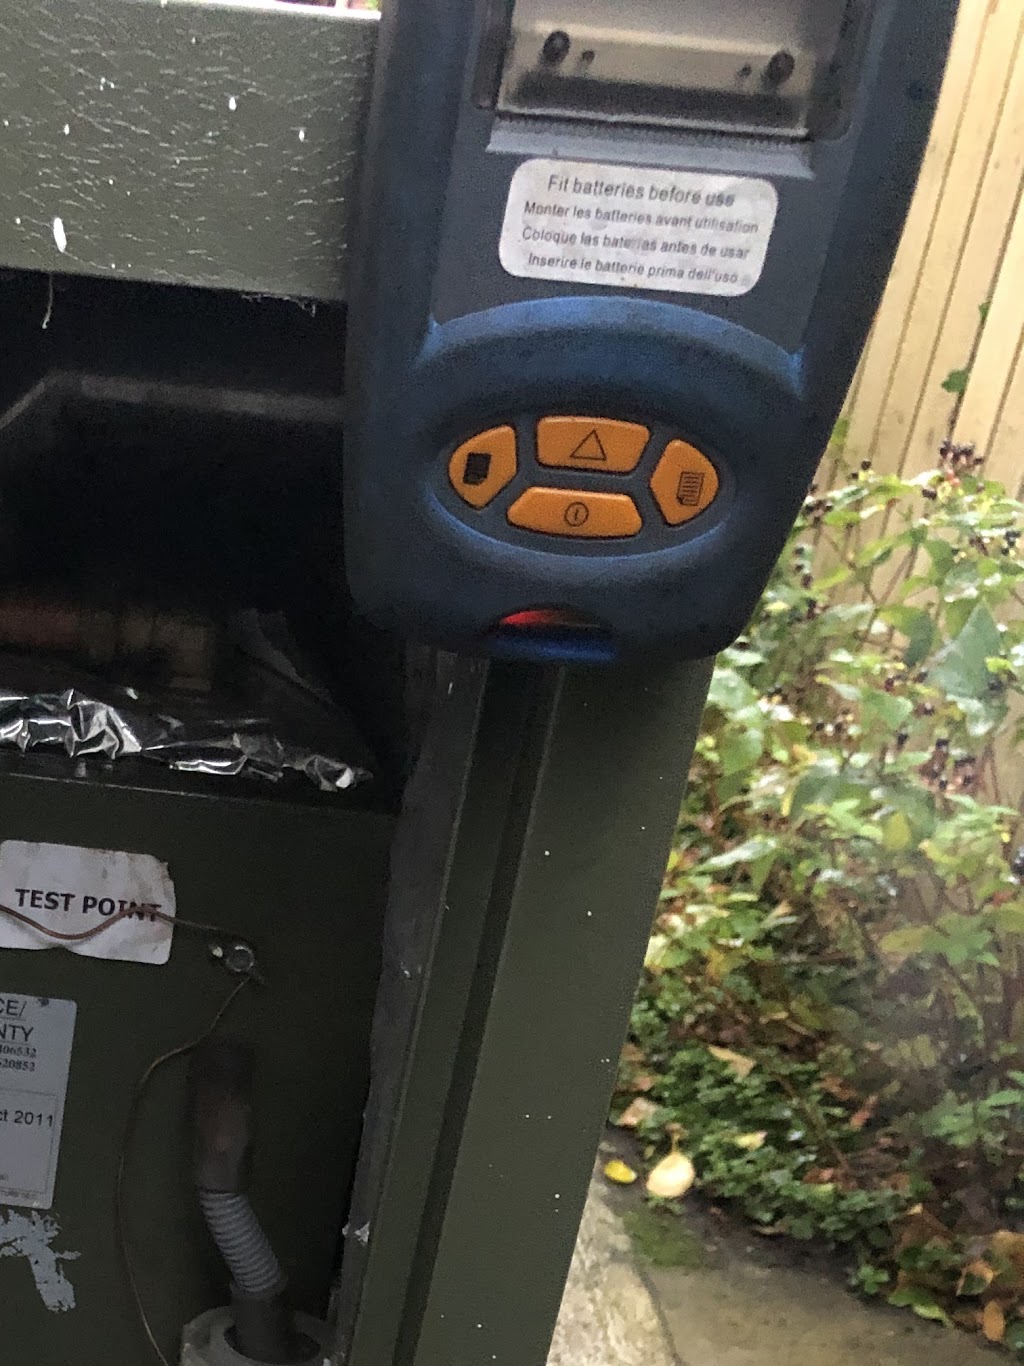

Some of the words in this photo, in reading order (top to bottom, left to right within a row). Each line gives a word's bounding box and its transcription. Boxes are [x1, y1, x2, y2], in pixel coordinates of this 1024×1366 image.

[547, 174, 569, 192] Fit
[572, 178, 644, 200] batteries
[649, 185, 701, 204] before
[705, 191, 736, 207] use
[524, 201, 569, 218] Monter
[573, 205, 591, 219] les
[595, 208, 653, 225] batteries
[656, 213, 692, 228] avant
[522, 226, 577, 245] Coloque
[580, 231, 599, 246] las
[660, 239, 697, 254] antes
[700, 242, 717, 256] de
[720, 246, 750, 260] usar
[528, 252, 577, 269] Inserire
[580, 256, 592, 270] le
[595, 259, 644, 276] batterie
[648, 266, 684, 281] prima
[14, 888, 76, 912] TEST
[82, 895, 163, 923] POINT
[13, 1109, 54, 1127] 2011
